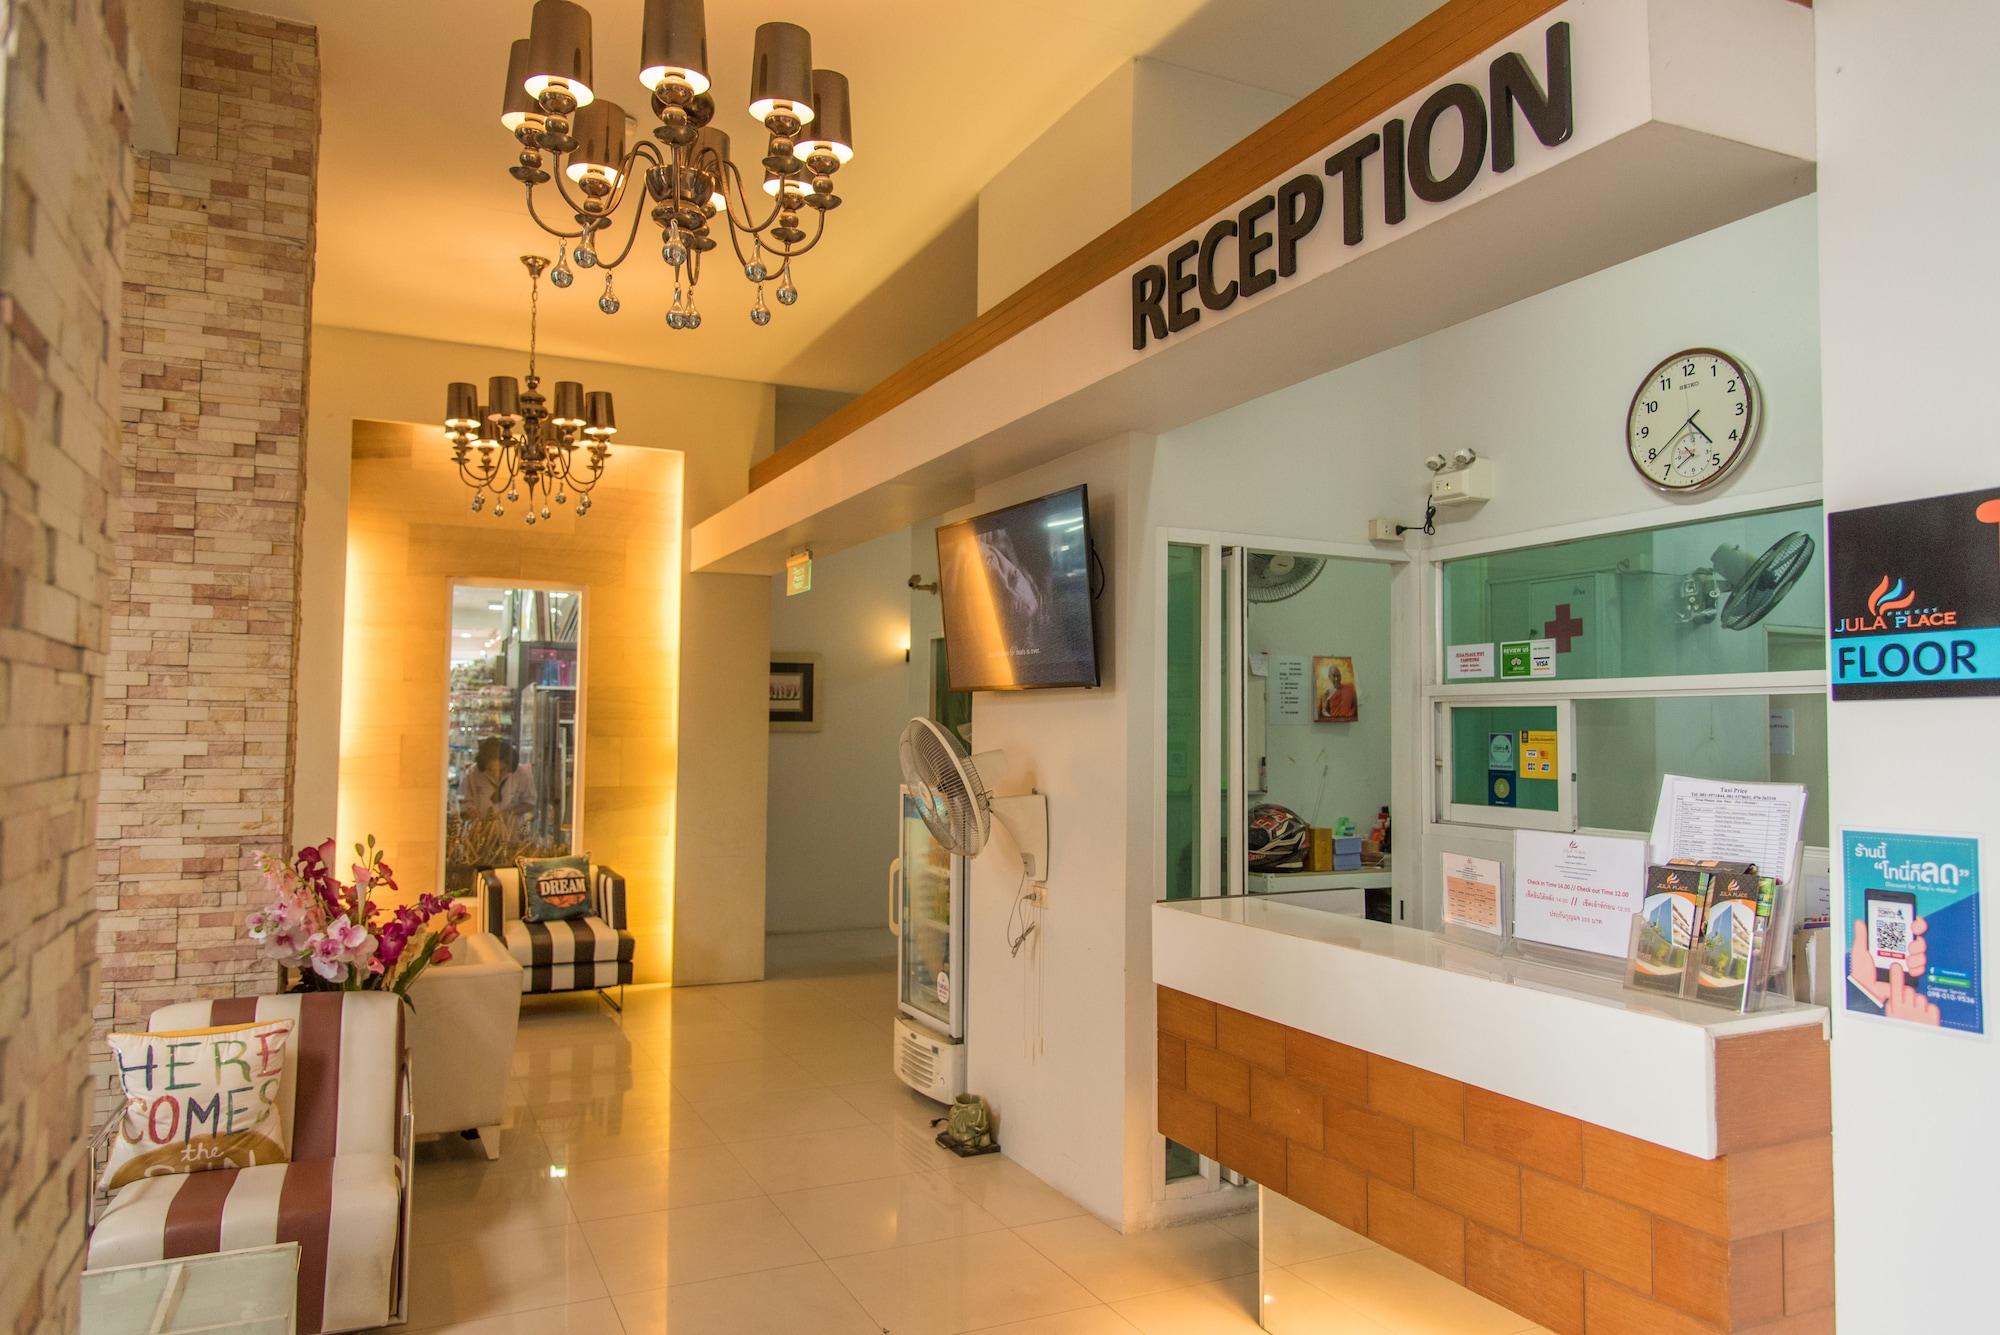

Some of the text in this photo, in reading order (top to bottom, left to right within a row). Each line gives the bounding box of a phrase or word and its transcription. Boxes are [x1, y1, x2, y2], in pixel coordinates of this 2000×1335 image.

[1132, 21, 1573, 350] RECEPTION
[1682, 363, 1695, 377] 12
[1710, 365, 1716, 377] 1
[1660, 378, 1671, 391] 11
[1727, 379, 1736, 393] 2
[1645, 401, 1658, 414] 10
[1735, 402, 1744, 416] 3
[1641, 426, 1649, 439] 9
[1728, 429, 1738, 441] 4
[1648, 448, 1657, 460] 8
[1712, 453, 1720, 466] 5
[1663, 464, 1671, 477] 7
[1887, 607, 1938, 616] PHUKET
[1834, 611, 1957, 633] JULA PLACE
[1838, 640, 1977, 679] FLOOR
[1855, 842, 1887, 859] ร้านนี้
[540, 878, 586, 896] DREAM
[1600, 888, 1613, 896] Time
[1614, 890, 1629, 898] 12.00
[118, 1028, 289, 1093] HERE
[122, 1078, 279, 1145] COMES
[180, 1143, 224, 1162] the
